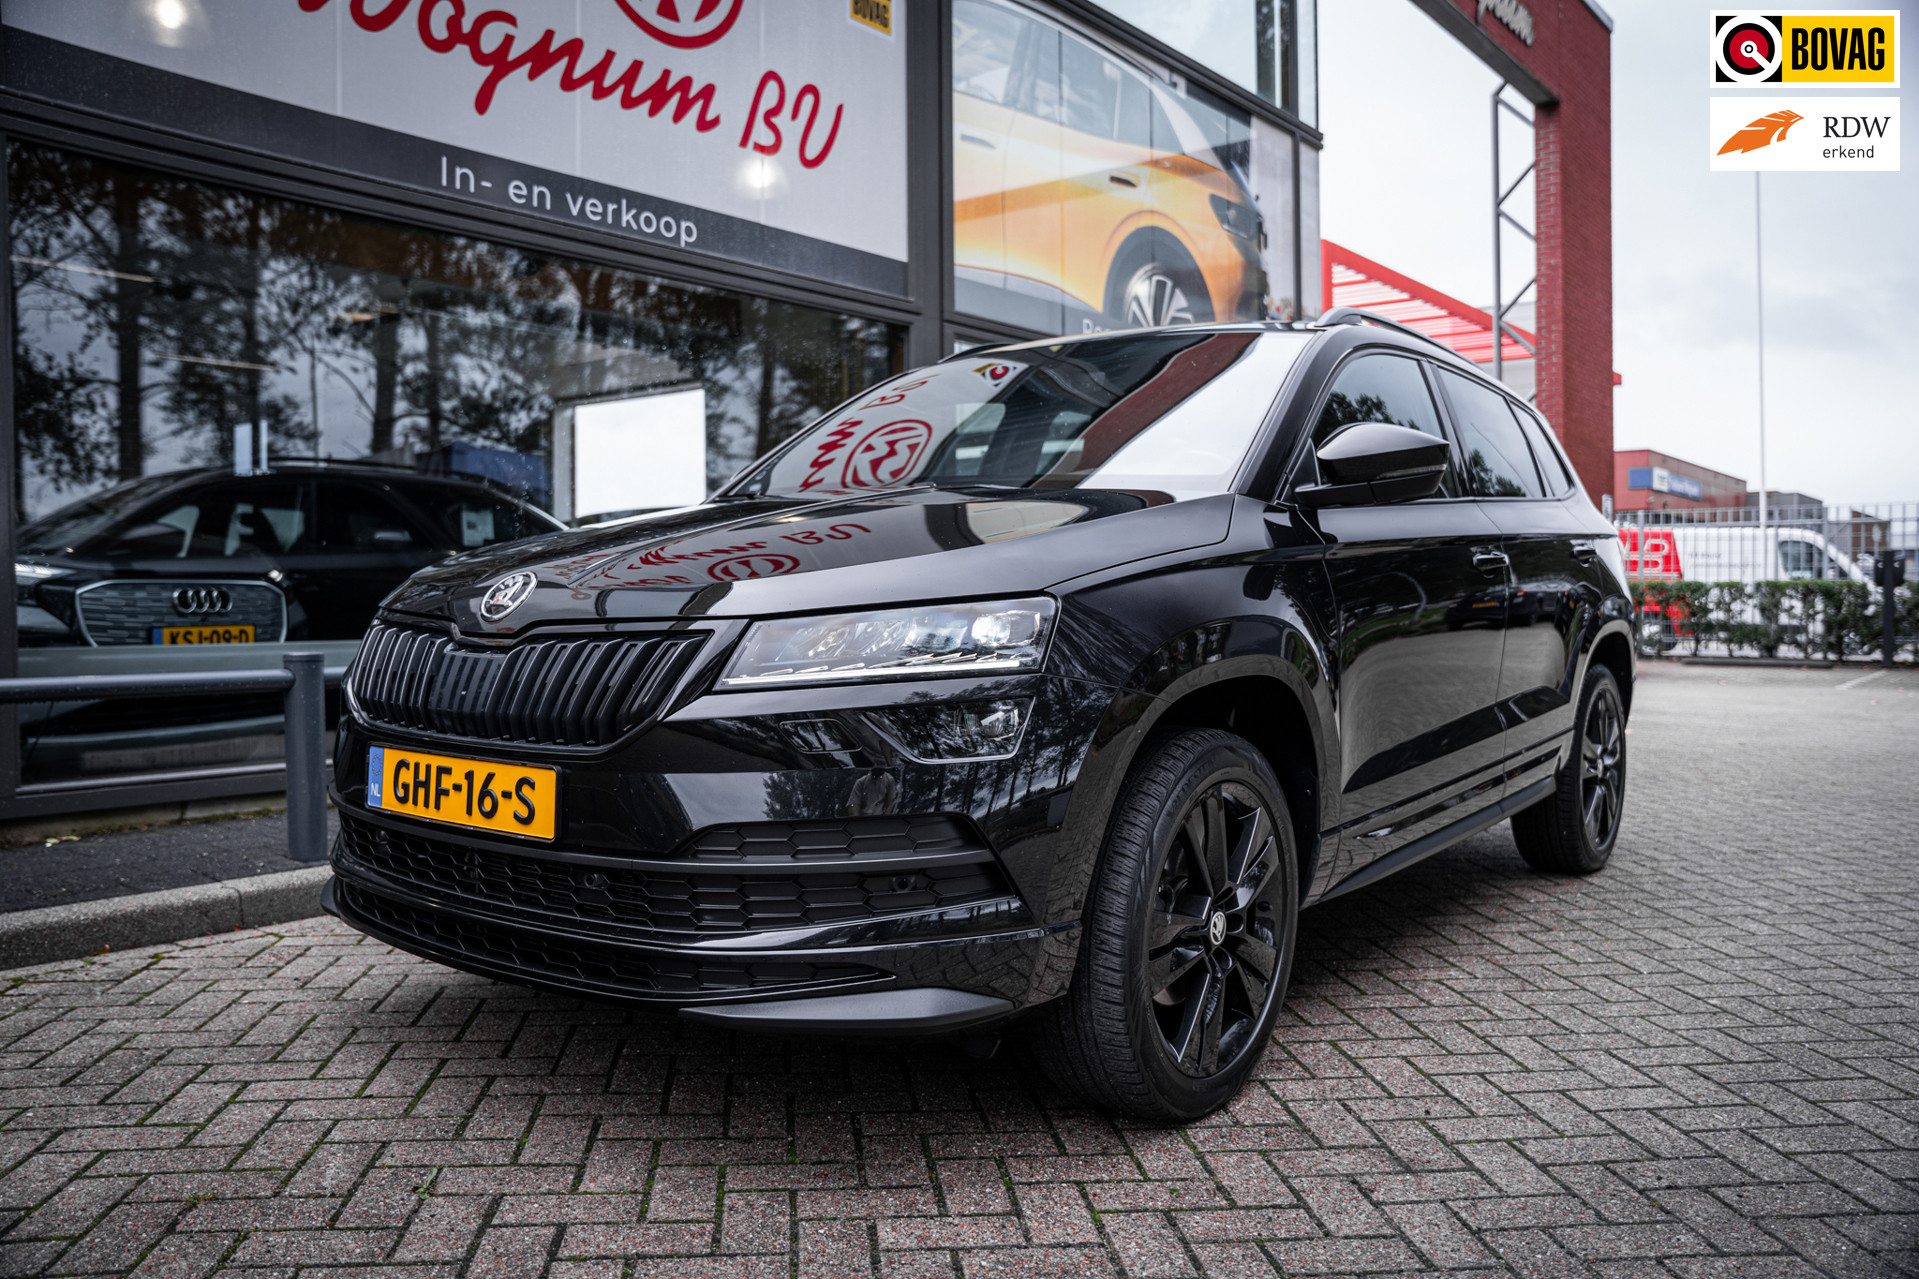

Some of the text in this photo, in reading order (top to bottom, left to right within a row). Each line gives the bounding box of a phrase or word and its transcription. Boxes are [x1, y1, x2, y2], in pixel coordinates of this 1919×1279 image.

[441, 155, 697, 248] In- en verkoop
[370, 782, 381, 797] NL
[393, 758, 536, 825] GHF-16-S
